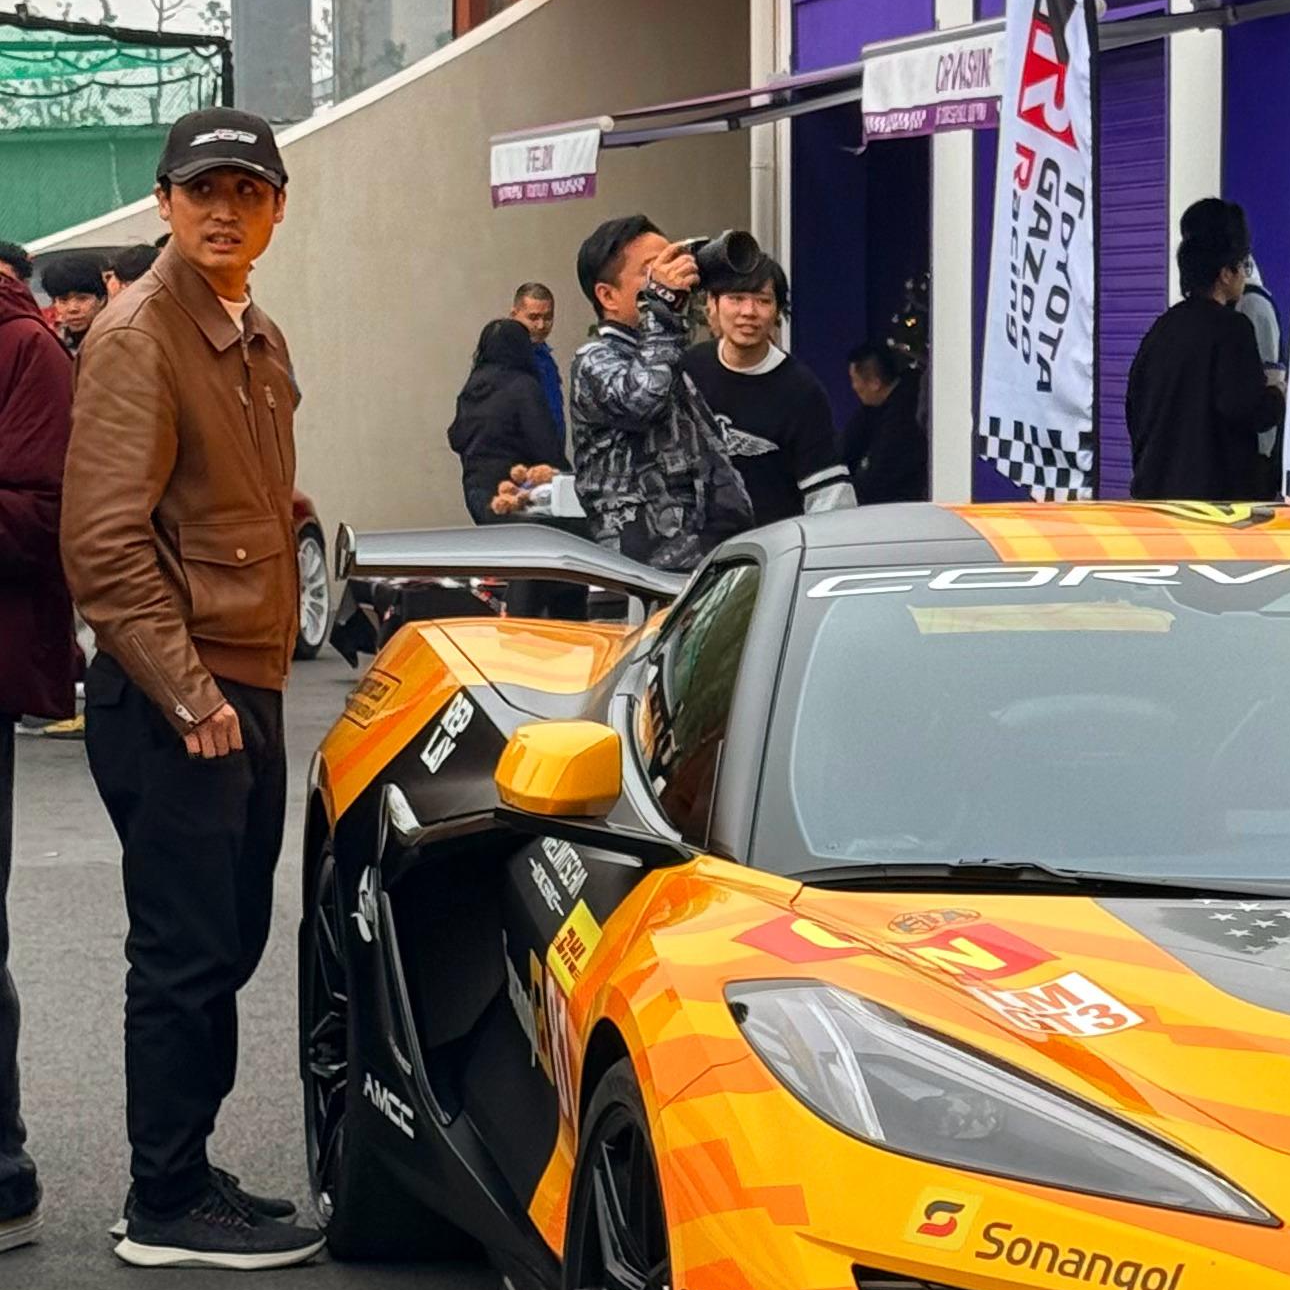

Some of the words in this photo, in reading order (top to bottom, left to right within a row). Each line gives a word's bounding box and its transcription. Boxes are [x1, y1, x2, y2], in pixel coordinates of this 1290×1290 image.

[1006, 141, 1037, 351] Racing
[1021, 157, 1061, 365] GAZOO
[1037, 178, 1086, 393] TOYOTA
